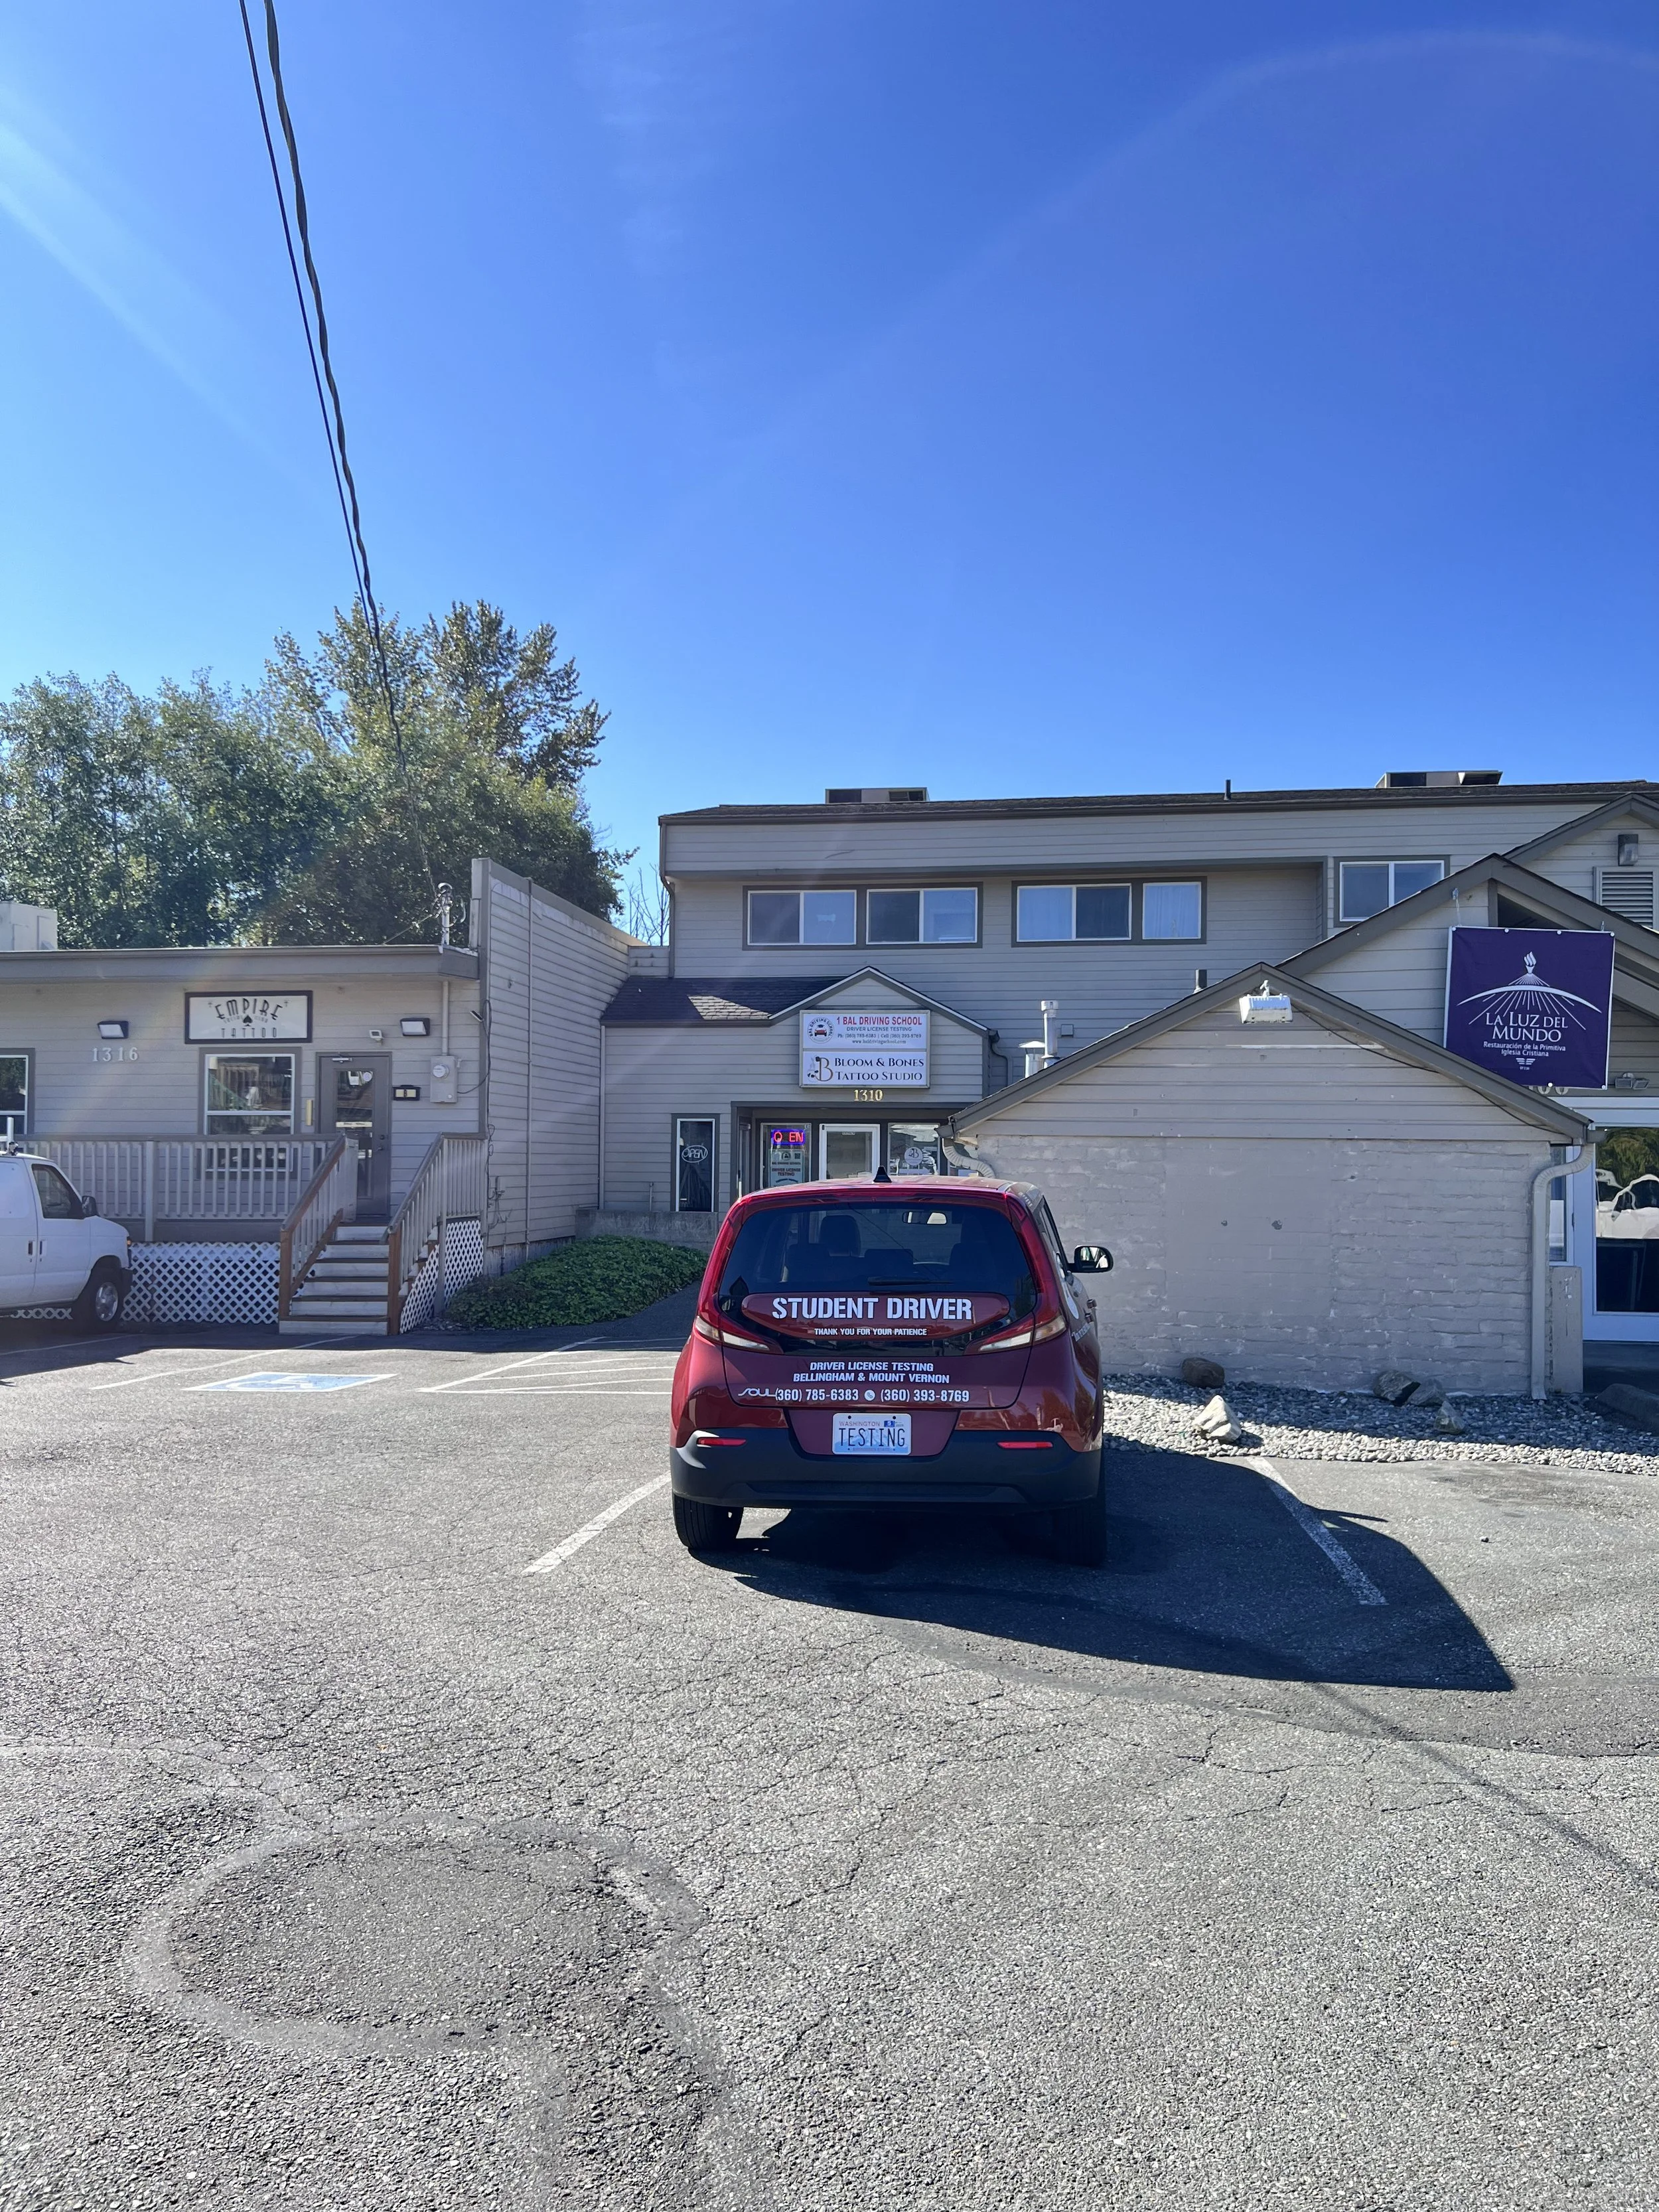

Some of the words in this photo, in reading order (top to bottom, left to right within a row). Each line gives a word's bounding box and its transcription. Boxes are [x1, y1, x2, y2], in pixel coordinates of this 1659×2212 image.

[215, 998, 283, 1020] EMPIRE
[836, 1016, 840, 1025] 1
[843, 1016, 857, 1025] BAL
[859, 1016, 890, 1025] DRIVING
[892, 1016, 922, 1025] SCHOOL
[1486, 1012, 1504, 1025] LA
[1510, 1011, 1540, 1027] LUZ
[1544, 1016, 1568, 1028] DEL
[221, 1027, 277, 1038] TATTOO
[1492, 1025, 1561, 1042] MUNDO
[92, 1047, 139, 1062] 1316
[835, 1058, 873, 1067] BLOOM
[876, 1058, 885, 1067] &
[889, 1058, 924, 1067] BONES
[835, 1070, 879, 1080] TATTOO
[882, 1071, 922, 1080] STUDIO
[853, 1089, 883, 1102] 1310
[774, 1131, 804, 1142] OEN
[683, 1148, 707, 1159] OPEN
[772, 1297, 879, 1319] STUDENT
[887, 1297, 972, 1320] DRIVER
[810, 1362, 845, 1370] DRIVER
[848, 1361, 889, 1370] LICENSE
[891, 1362, 934, 1372] TESTING
[793, 1372, 855, 1382] BELLINGHAM
[857, 1372, 866, 1382] &
[869, 1372, 905, 1382] MOUNT
[909, 1373, 950, 1384] VERNON
[738, 1388, 776, 1397] SOUL
[775, 1388, 802, 1402] (360)
[806, 1388, 859, 1401] 785-6383
[881, 1389, 910, 1402] (360)
[913, 1389, 970, 1402] 393-8769
[839, 1428, 905, 1446] TESTING
